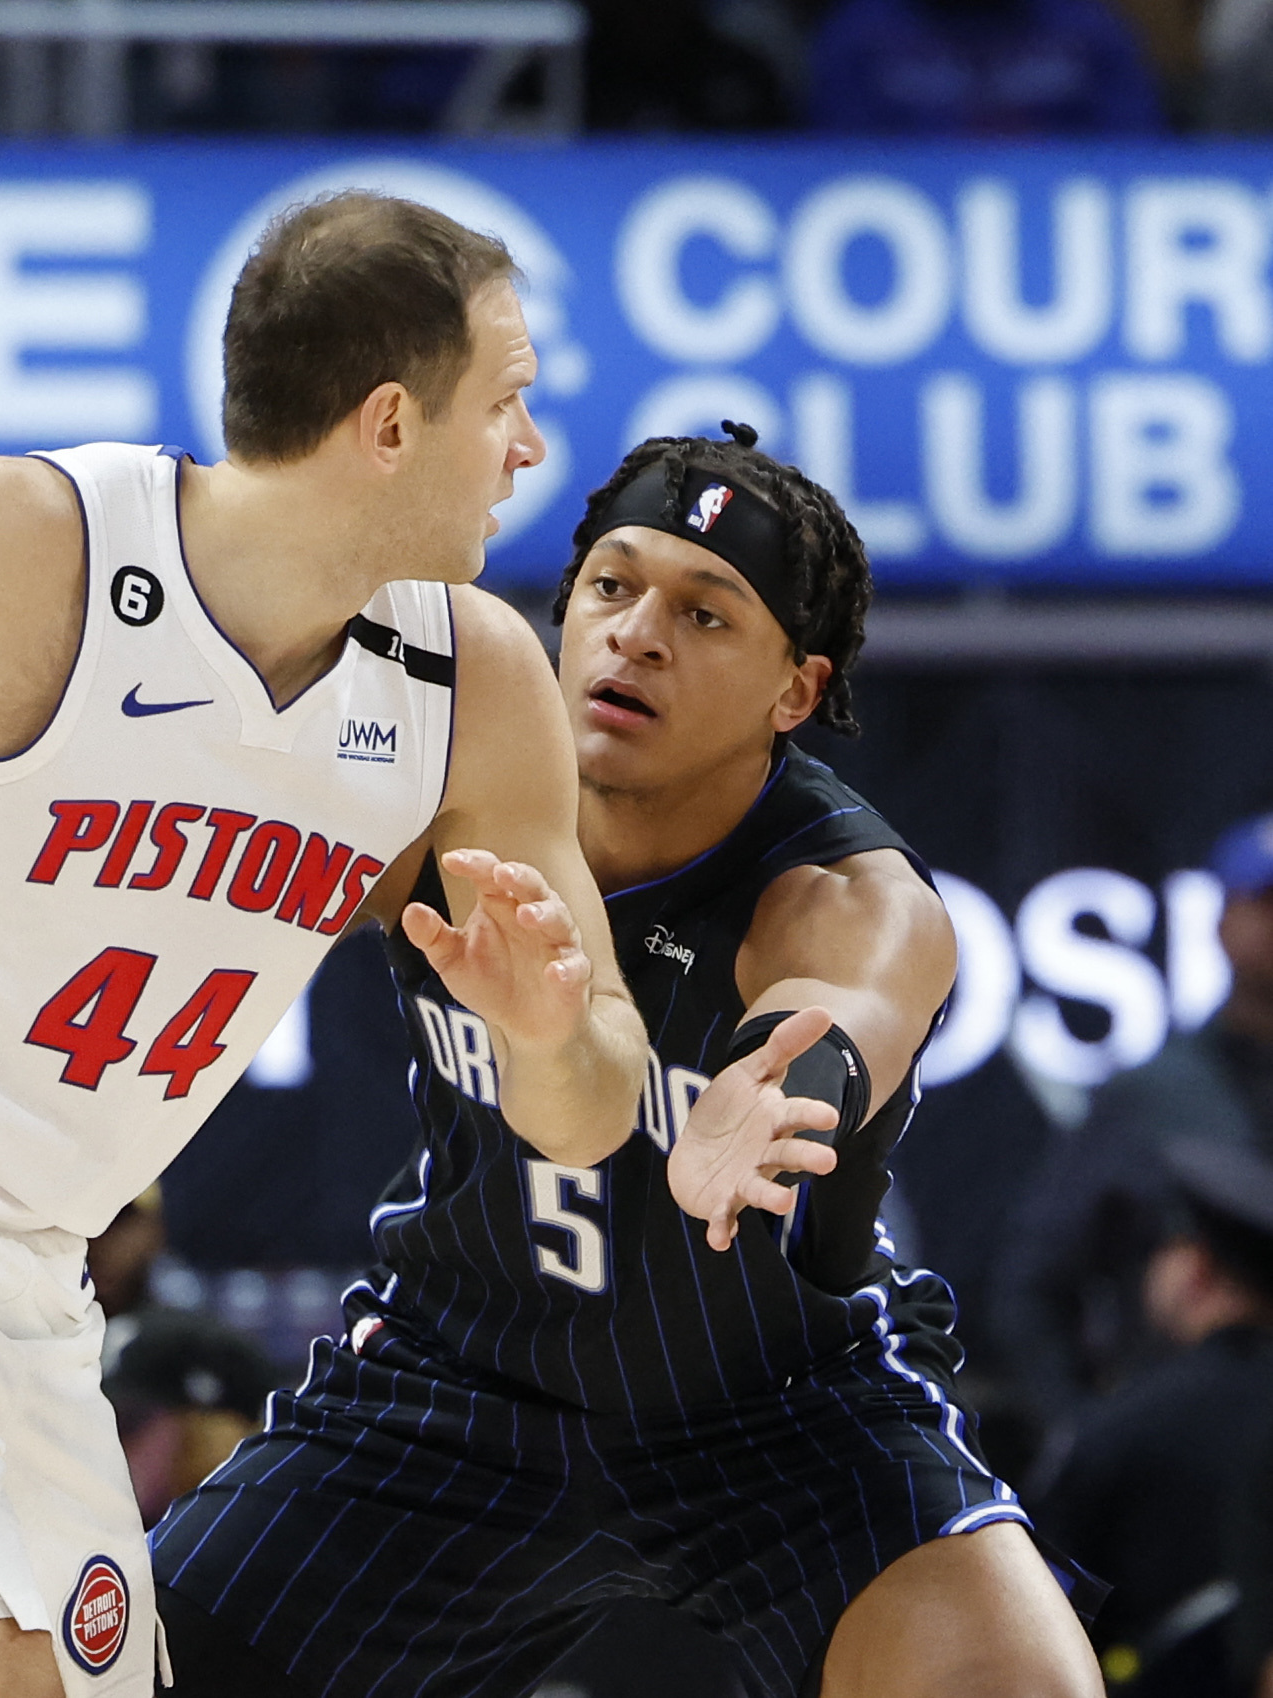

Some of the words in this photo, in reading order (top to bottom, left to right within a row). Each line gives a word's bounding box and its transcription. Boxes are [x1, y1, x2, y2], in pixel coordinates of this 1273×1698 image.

[118, 574, 152, 621] 6
[338, 718, 397, 752] UWM
[26, 799, 386, 936] PISTONS
[23, 946, 259, 1102] 44
[525, 1158, 608, 1294] 5
[82, 1588, 117, 1623] DETROIT
[83, 1607, 119, 1642] PISTONS
